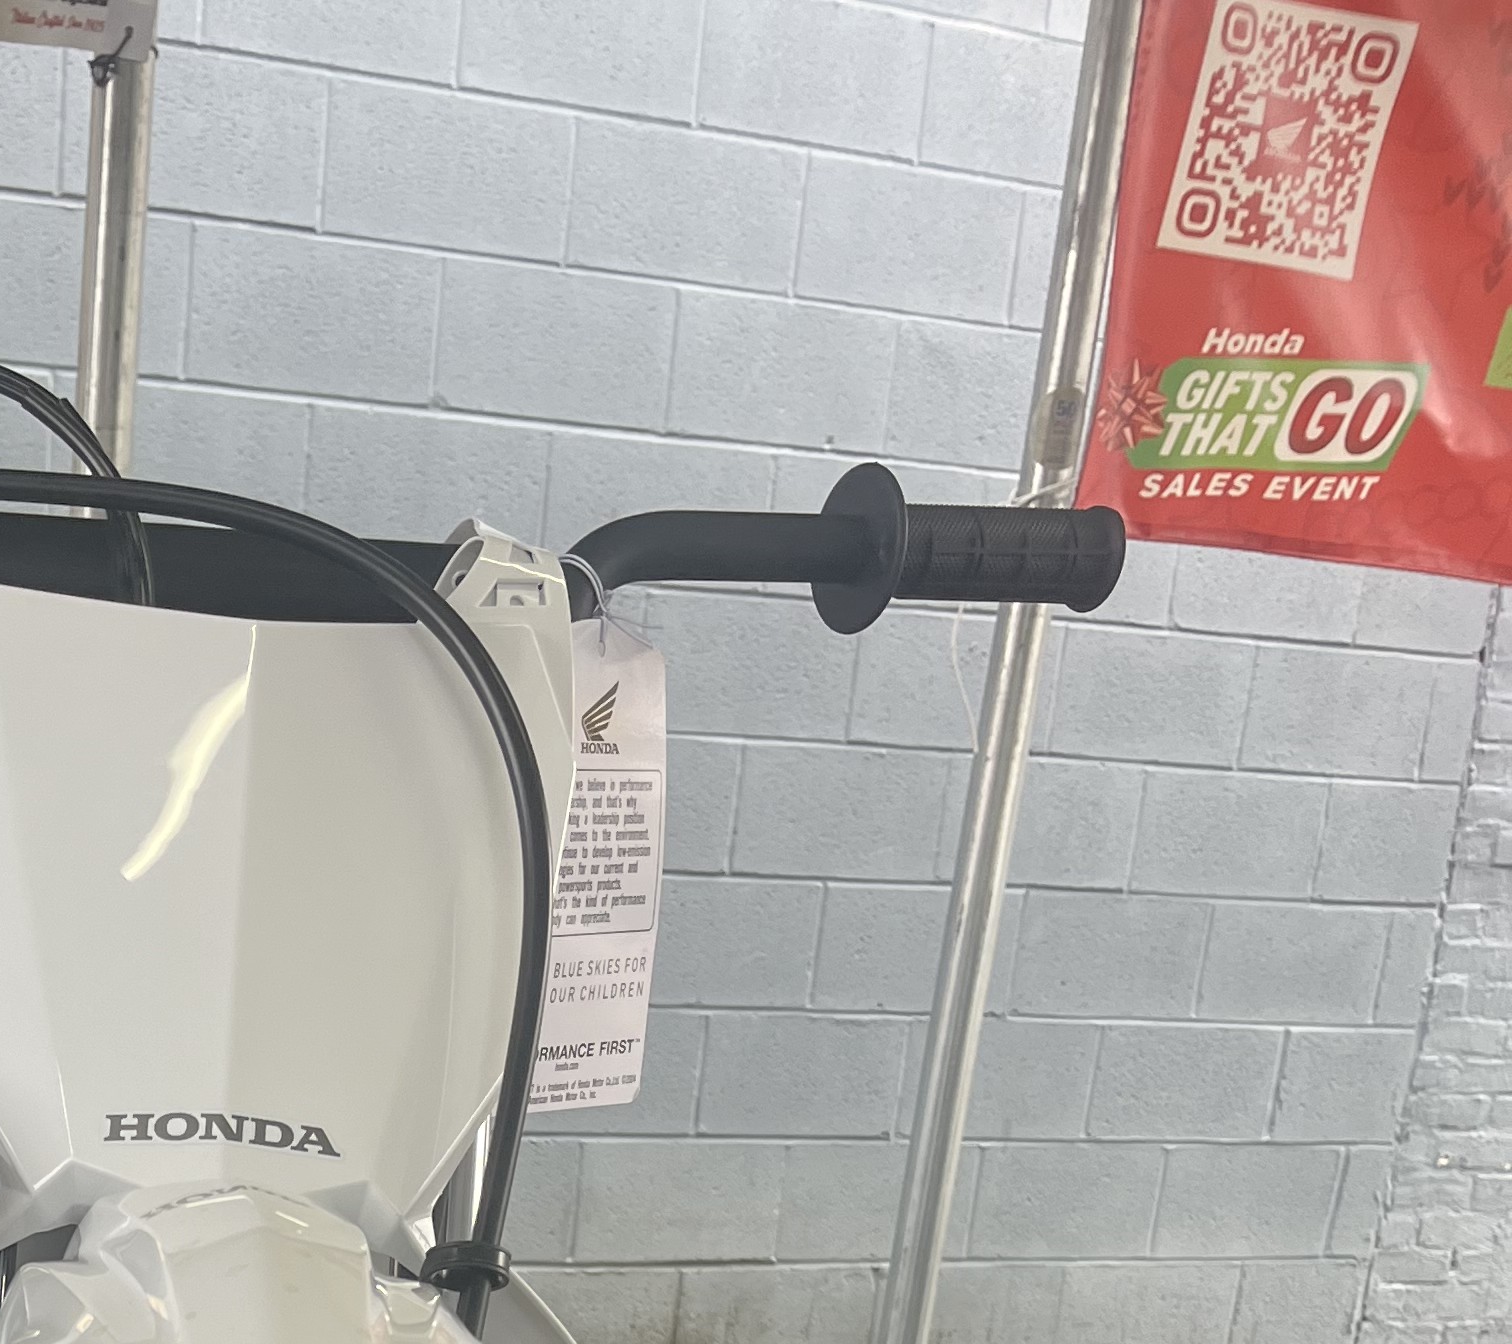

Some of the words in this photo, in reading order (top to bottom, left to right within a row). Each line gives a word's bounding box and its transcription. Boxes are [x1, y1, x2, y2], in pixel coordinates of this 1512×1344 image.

[1201, 327, 1305, 355] Honda
[1175, 369, 1296, 412] GIFTS
[1287, 375, 1407, 455] GO
[1158, 413, 1279, 456] THAT
[1138, 472, 1254, 498] SALES
[1262, 475, 1381, 501] EVENT
[580, 741, 619, 755] HONDA
[552, 960, 584, 979] BLUE
[586, 958, 620, 976] SKIES
[624, 956, 647, 973] FOR
[549, 986, 575, 1004] OUR
[579, 981, 645, 1001] CHILDREN
[103, 1112, 341, 1157] HONDA
